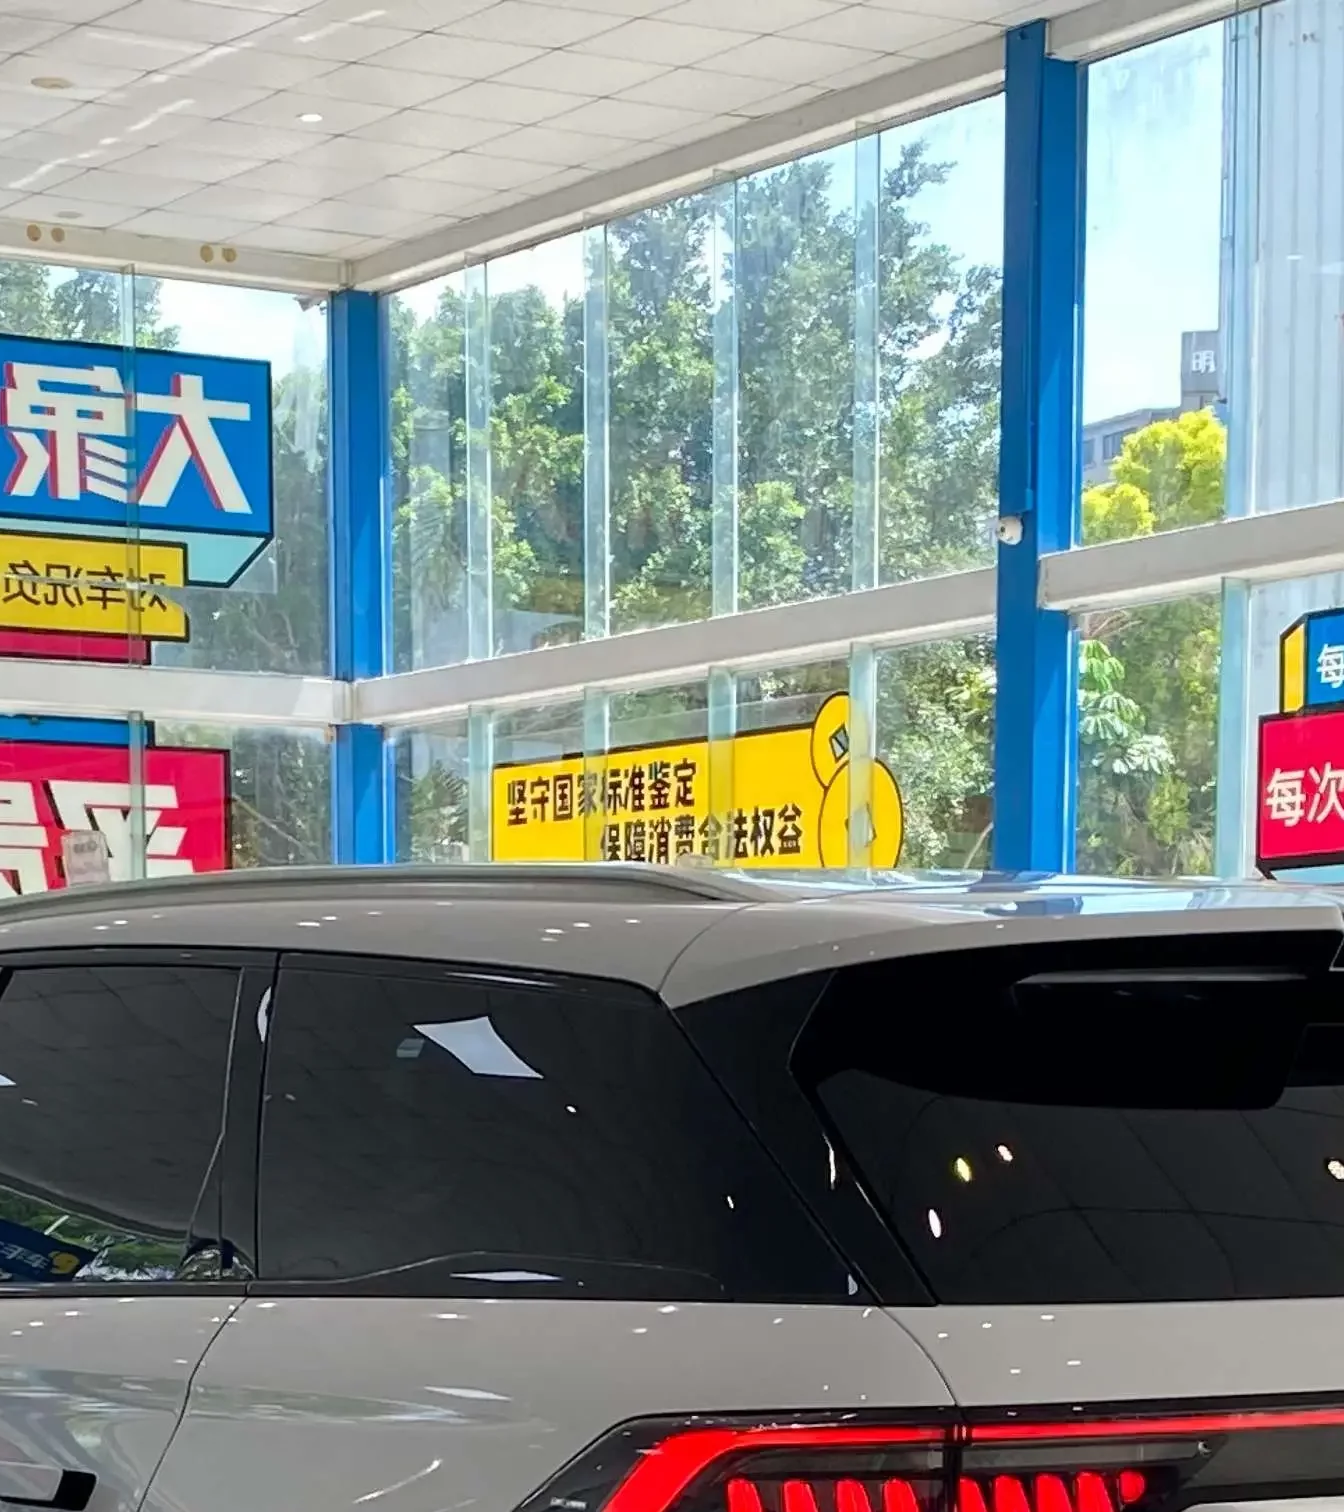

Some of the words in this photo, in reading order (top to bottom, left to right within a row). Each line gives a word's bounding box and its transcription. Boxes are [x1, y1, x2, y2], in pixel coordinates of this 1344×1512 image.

[506, 758, 696, 827] 坚守国家标准鉴定
